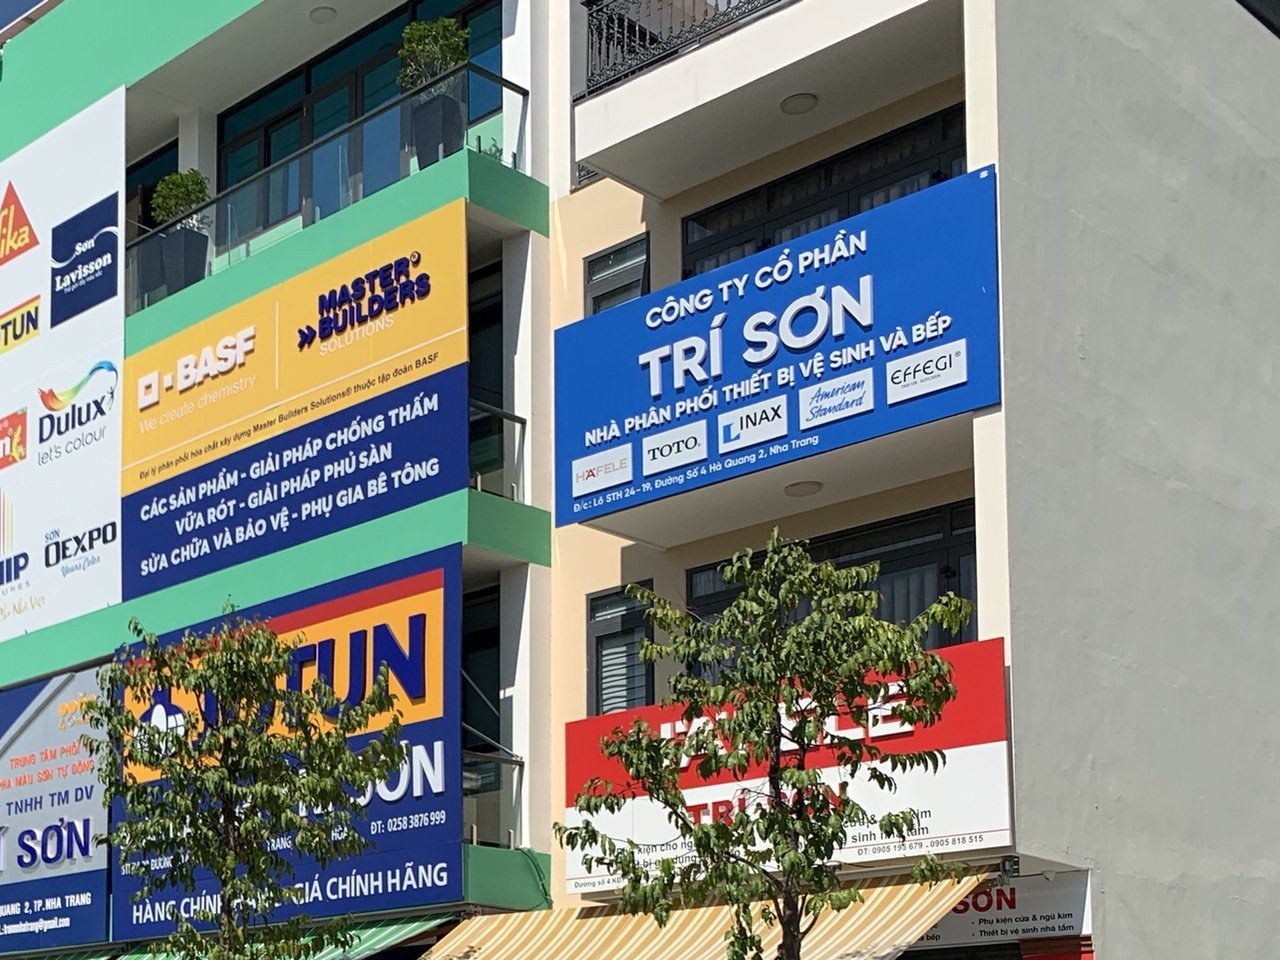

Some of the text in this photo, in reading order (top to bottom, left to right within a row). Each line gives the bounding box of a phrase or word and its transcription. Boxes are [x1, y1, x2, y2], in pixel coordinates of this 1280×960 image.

[53, 252, 112, 292] Lavisson
[644, 227, 868, 329] CÔNG TY CỔ PHẦN
[319, 272, 431, 342] BUILDERS
[319, 313, 396, 358] SOLUTIONS
[639, 274, 875, 399] TRÍ SƠN
[176, 325, 258, 395] BASF
[583, 310, 954, 447] NHÀ PHÂN PHỐI THIẾT BỊ VỆ SINH VÀ BẾP
[196, 374, 257, 411] chemistry
[252, 417, 278, 437] Master
[278, 406, 310, 427] Builders
[391, 363, 415, 383] đoàn
[414, 352, 441, 374] BASF
[804, 396, 867, 423] Standard
[808, 379, 867, 406] American
[38, 395, 108, 444] Dulux
[739, 404, 783, 432] INAX
[64, 424, 107, 456] colour
[140, 392, 440, 522] CÁC SẢN PHẨM GIẢI PHÁP CHỐNG THẤM
[647, 434, 699, 462] TOTO
[175, 440, 393, 536] VỮA RÓT GIẢI PHÁP PHỦ SÀN
[605, 489, 624, 504] STH
[654, 470, 685, 491] Đường
[686, 464, 700, 482] Số
[700, 466, 708, 478] 4
[709, 459, 722, 475] Hà
[723, 451, 758, 473] Quang
[769, 442, 789, 459] Nha
[791, 434, 820, 457] Trang
[140, 457, 441, 577] SỬA CHỮA VÀ BẢO VỆ PHỤ GIA BÊ TÔNG
[44, 520, 118, 569] OEXPO
[6, 795, 43, 817] TNHH
[48, 789, 70, 809] TM
[75, 784, 95, 803] DV
[16, 817, 94, 871] SƠN
[370, 810, 447, 837] ĐT: 0258 3876 999
[850, 828, 877, 844] sinh
[64, 892, 93, 908] TRANG
[326, 868, 384, 902] CHÍNH
[387, 860, 449, 894] HÃNG
[1021, 925, 1039, 935] sinh
[1031, 914, 1038, 922] &
[1057, 911, 1074, 920] kim
